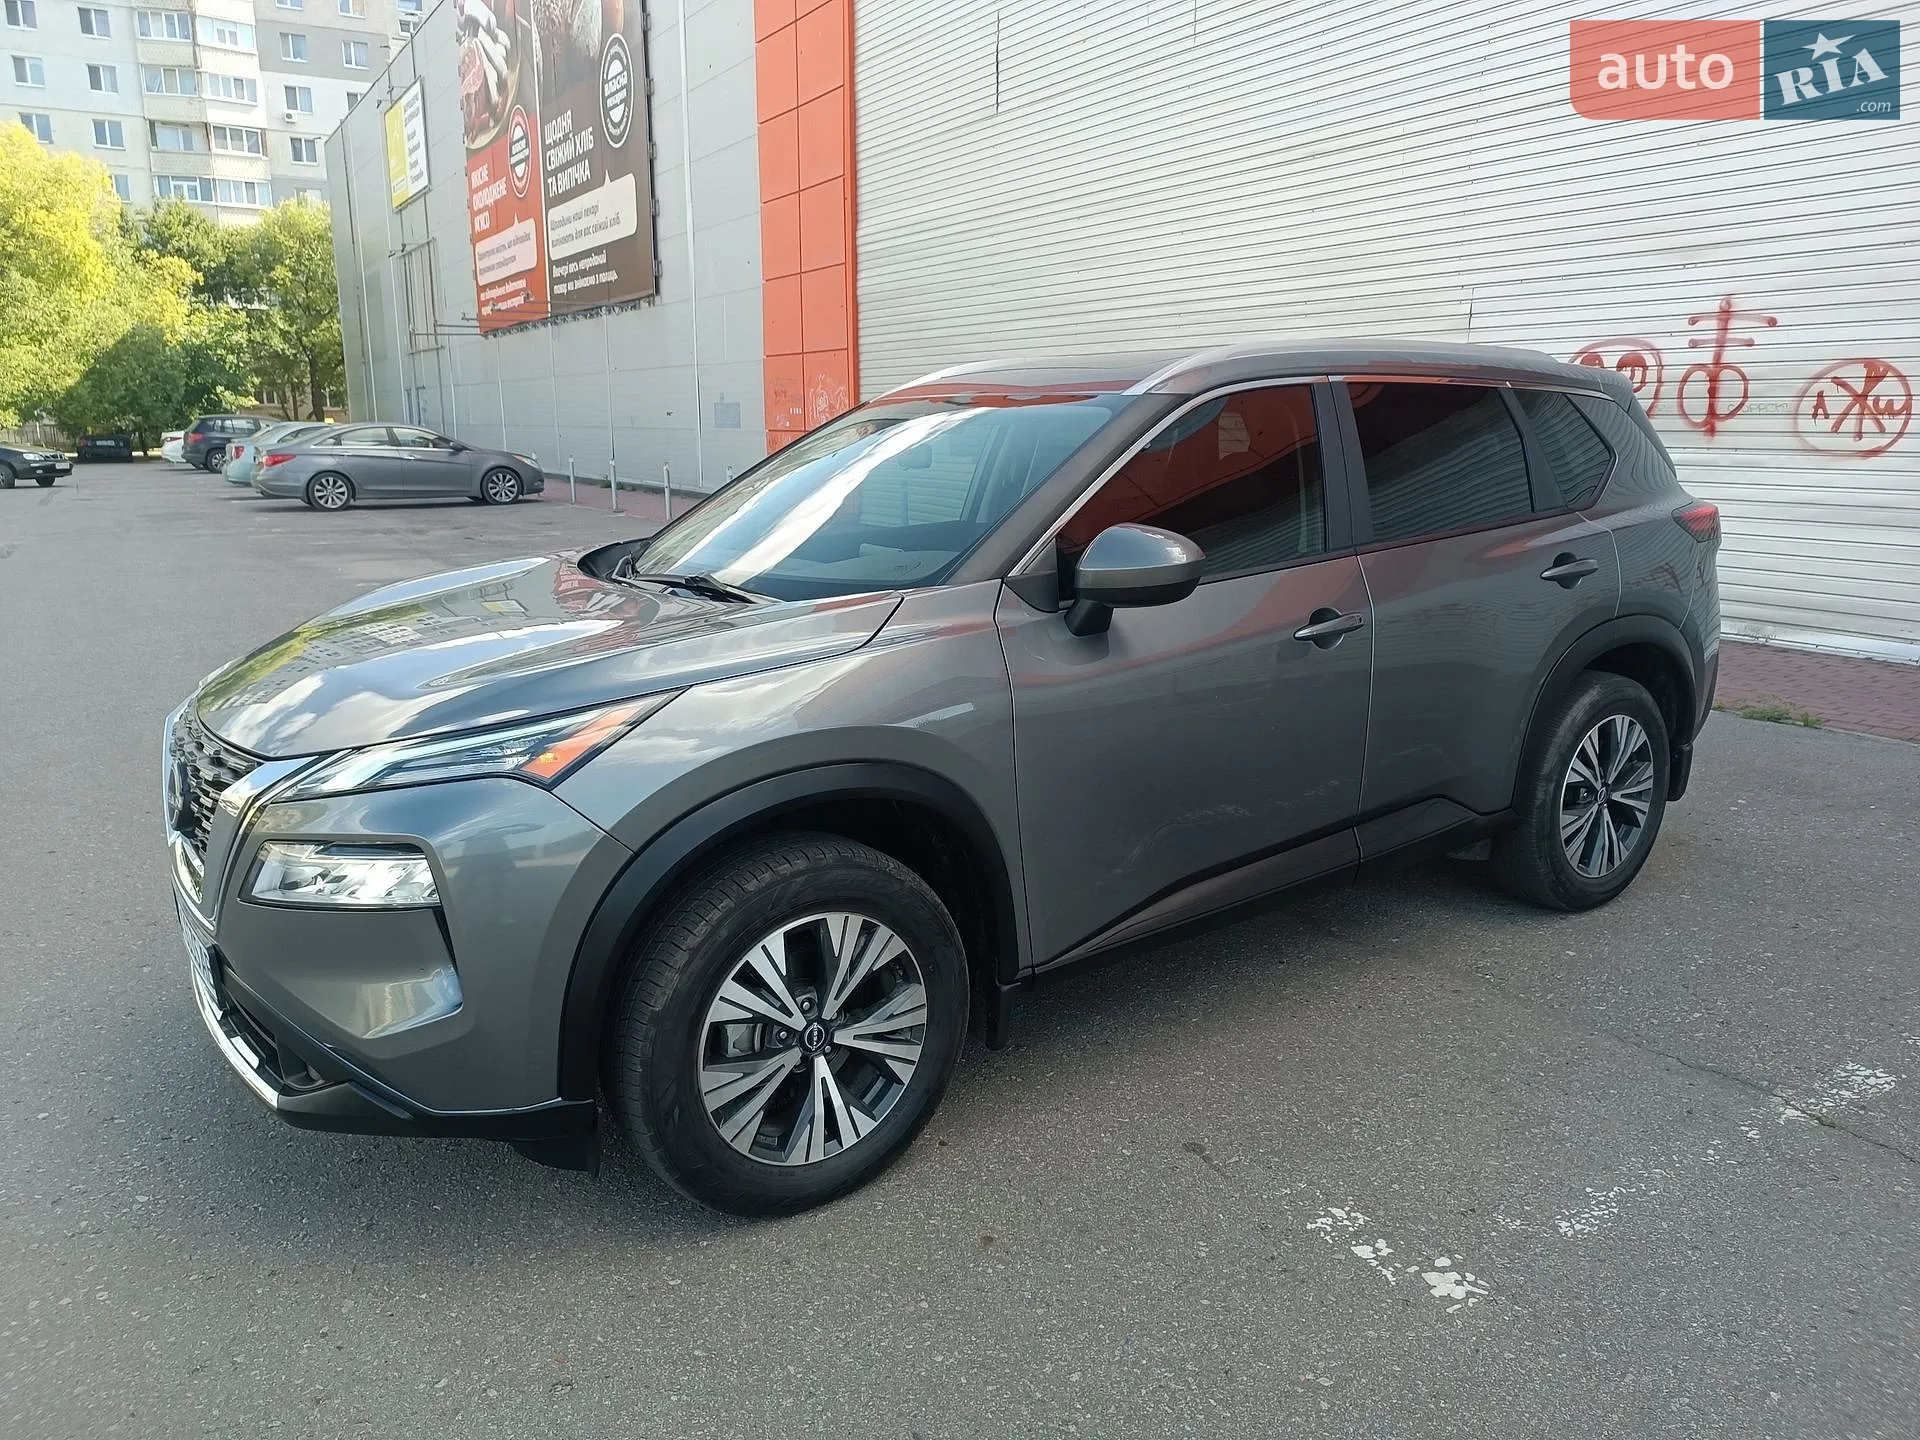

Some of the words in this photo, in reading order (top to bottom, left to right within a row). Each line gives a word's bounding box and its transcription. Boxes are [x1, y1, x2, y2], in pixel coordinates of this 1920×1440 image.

[545, 109, 573, 146] ЩОДНЯ
[547, 132, 575, 171] СВІЖИЙ
[575, 126, 595, 157] ХЛІБ
[547, 175, 557, 198] ТА
[557, 158, 591, 194] ВИПІЧКА
